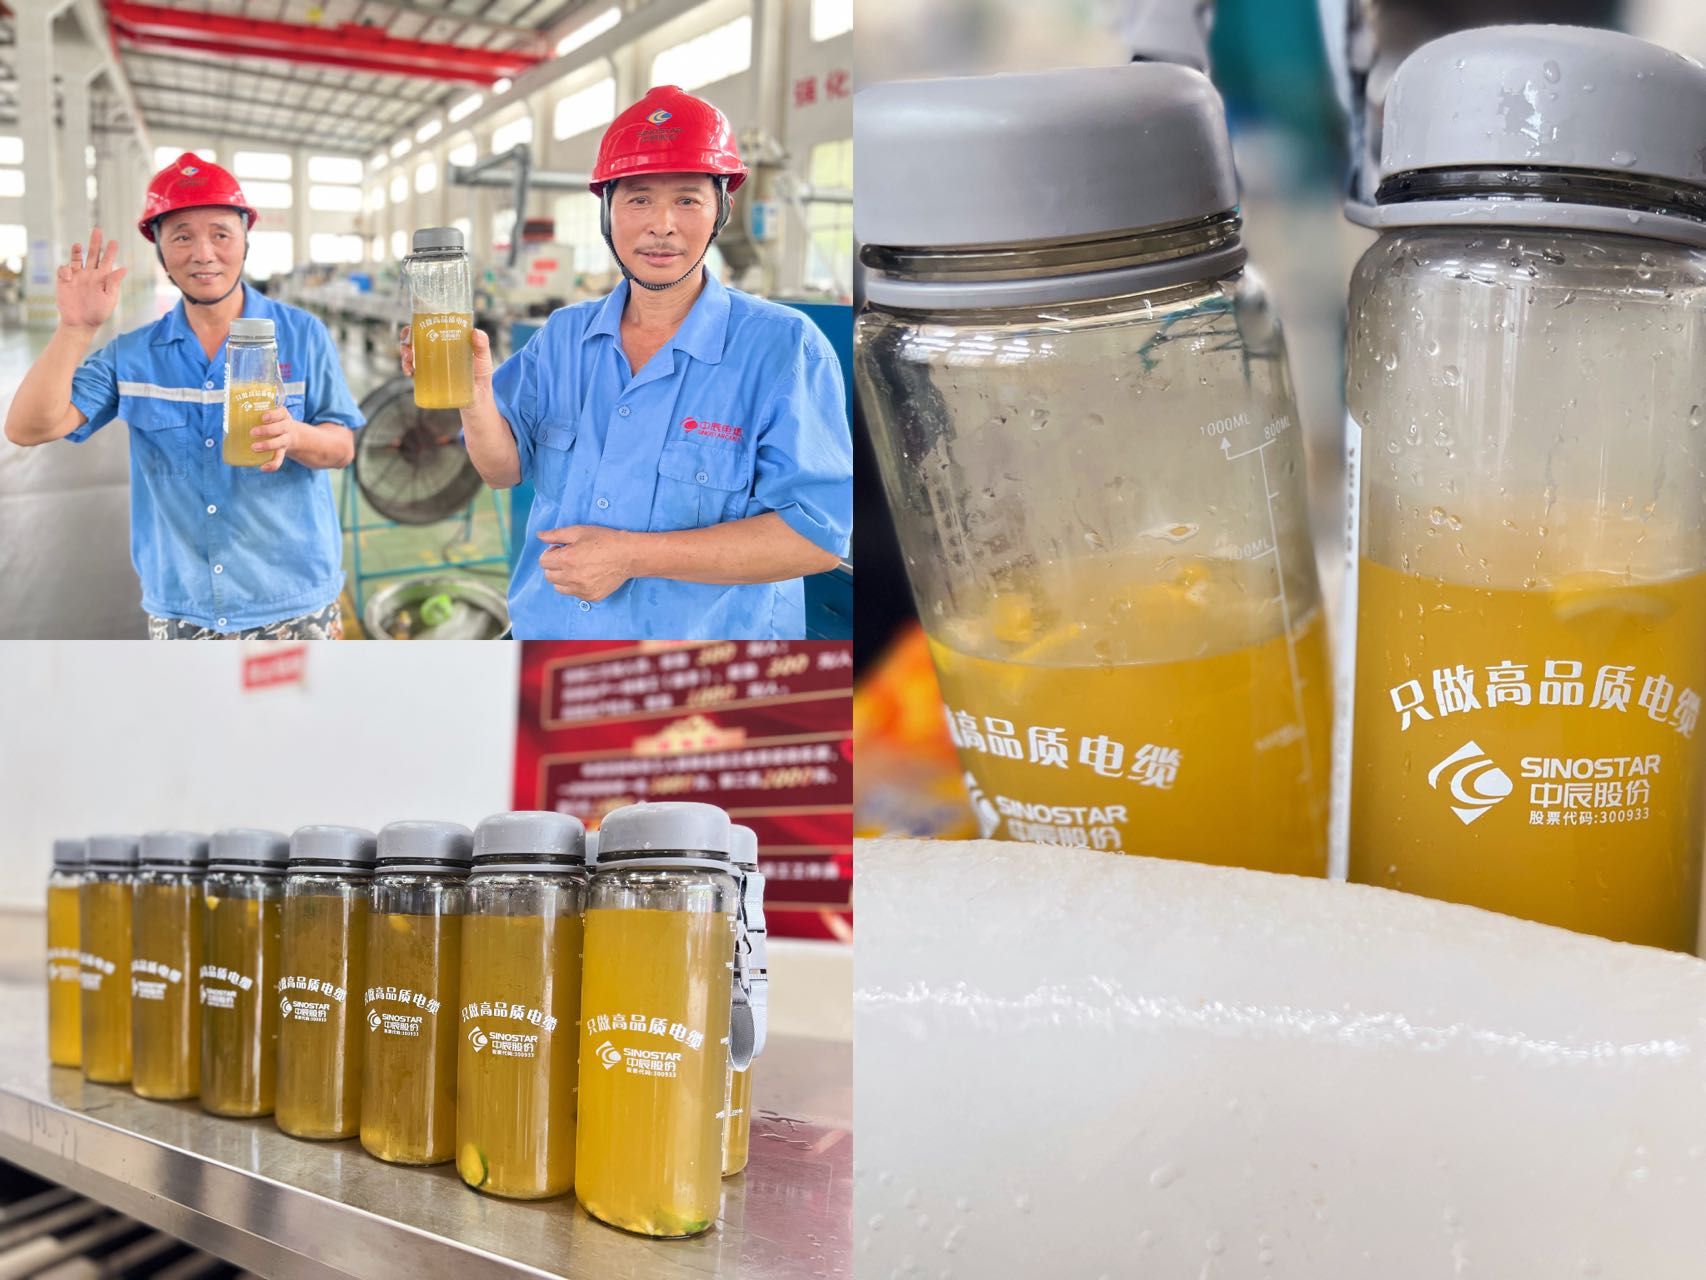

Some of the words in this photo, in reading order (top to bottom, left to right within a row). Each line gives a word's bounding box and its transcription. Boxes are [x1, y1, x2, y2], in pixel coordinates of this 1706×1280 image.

[1200, 413, 1251, 437] 1000ML
[1264, 415, 1292, 440] 800ML
[1390, 660, 1701, 740] 只做高品质电缆
[1520, 754, 1661, 779] SINOSTAR
[1530, 779, 1650, 809] 中辰股份
[996, 795, 1128, 826] SINOSTAR
[1529, 807, 1650, 826] 股票代码:300933
[292, 1001, 330, 1010] SINOSTAR
[461, 1001, 558, 1033] 只做高品质电缆
[382, 1013, 423, 1023] SINOSTAR
[489, 1031, 538, 1043] SINOSTAR
[587, 1013, 704, 1052] 只做高品质电缆
[492, 1040, 534, 1053] 中辰股份
[623, 1047, 682, 1062] SINOSTAR
[626, 1057, 677, 1072] 中辰股份
